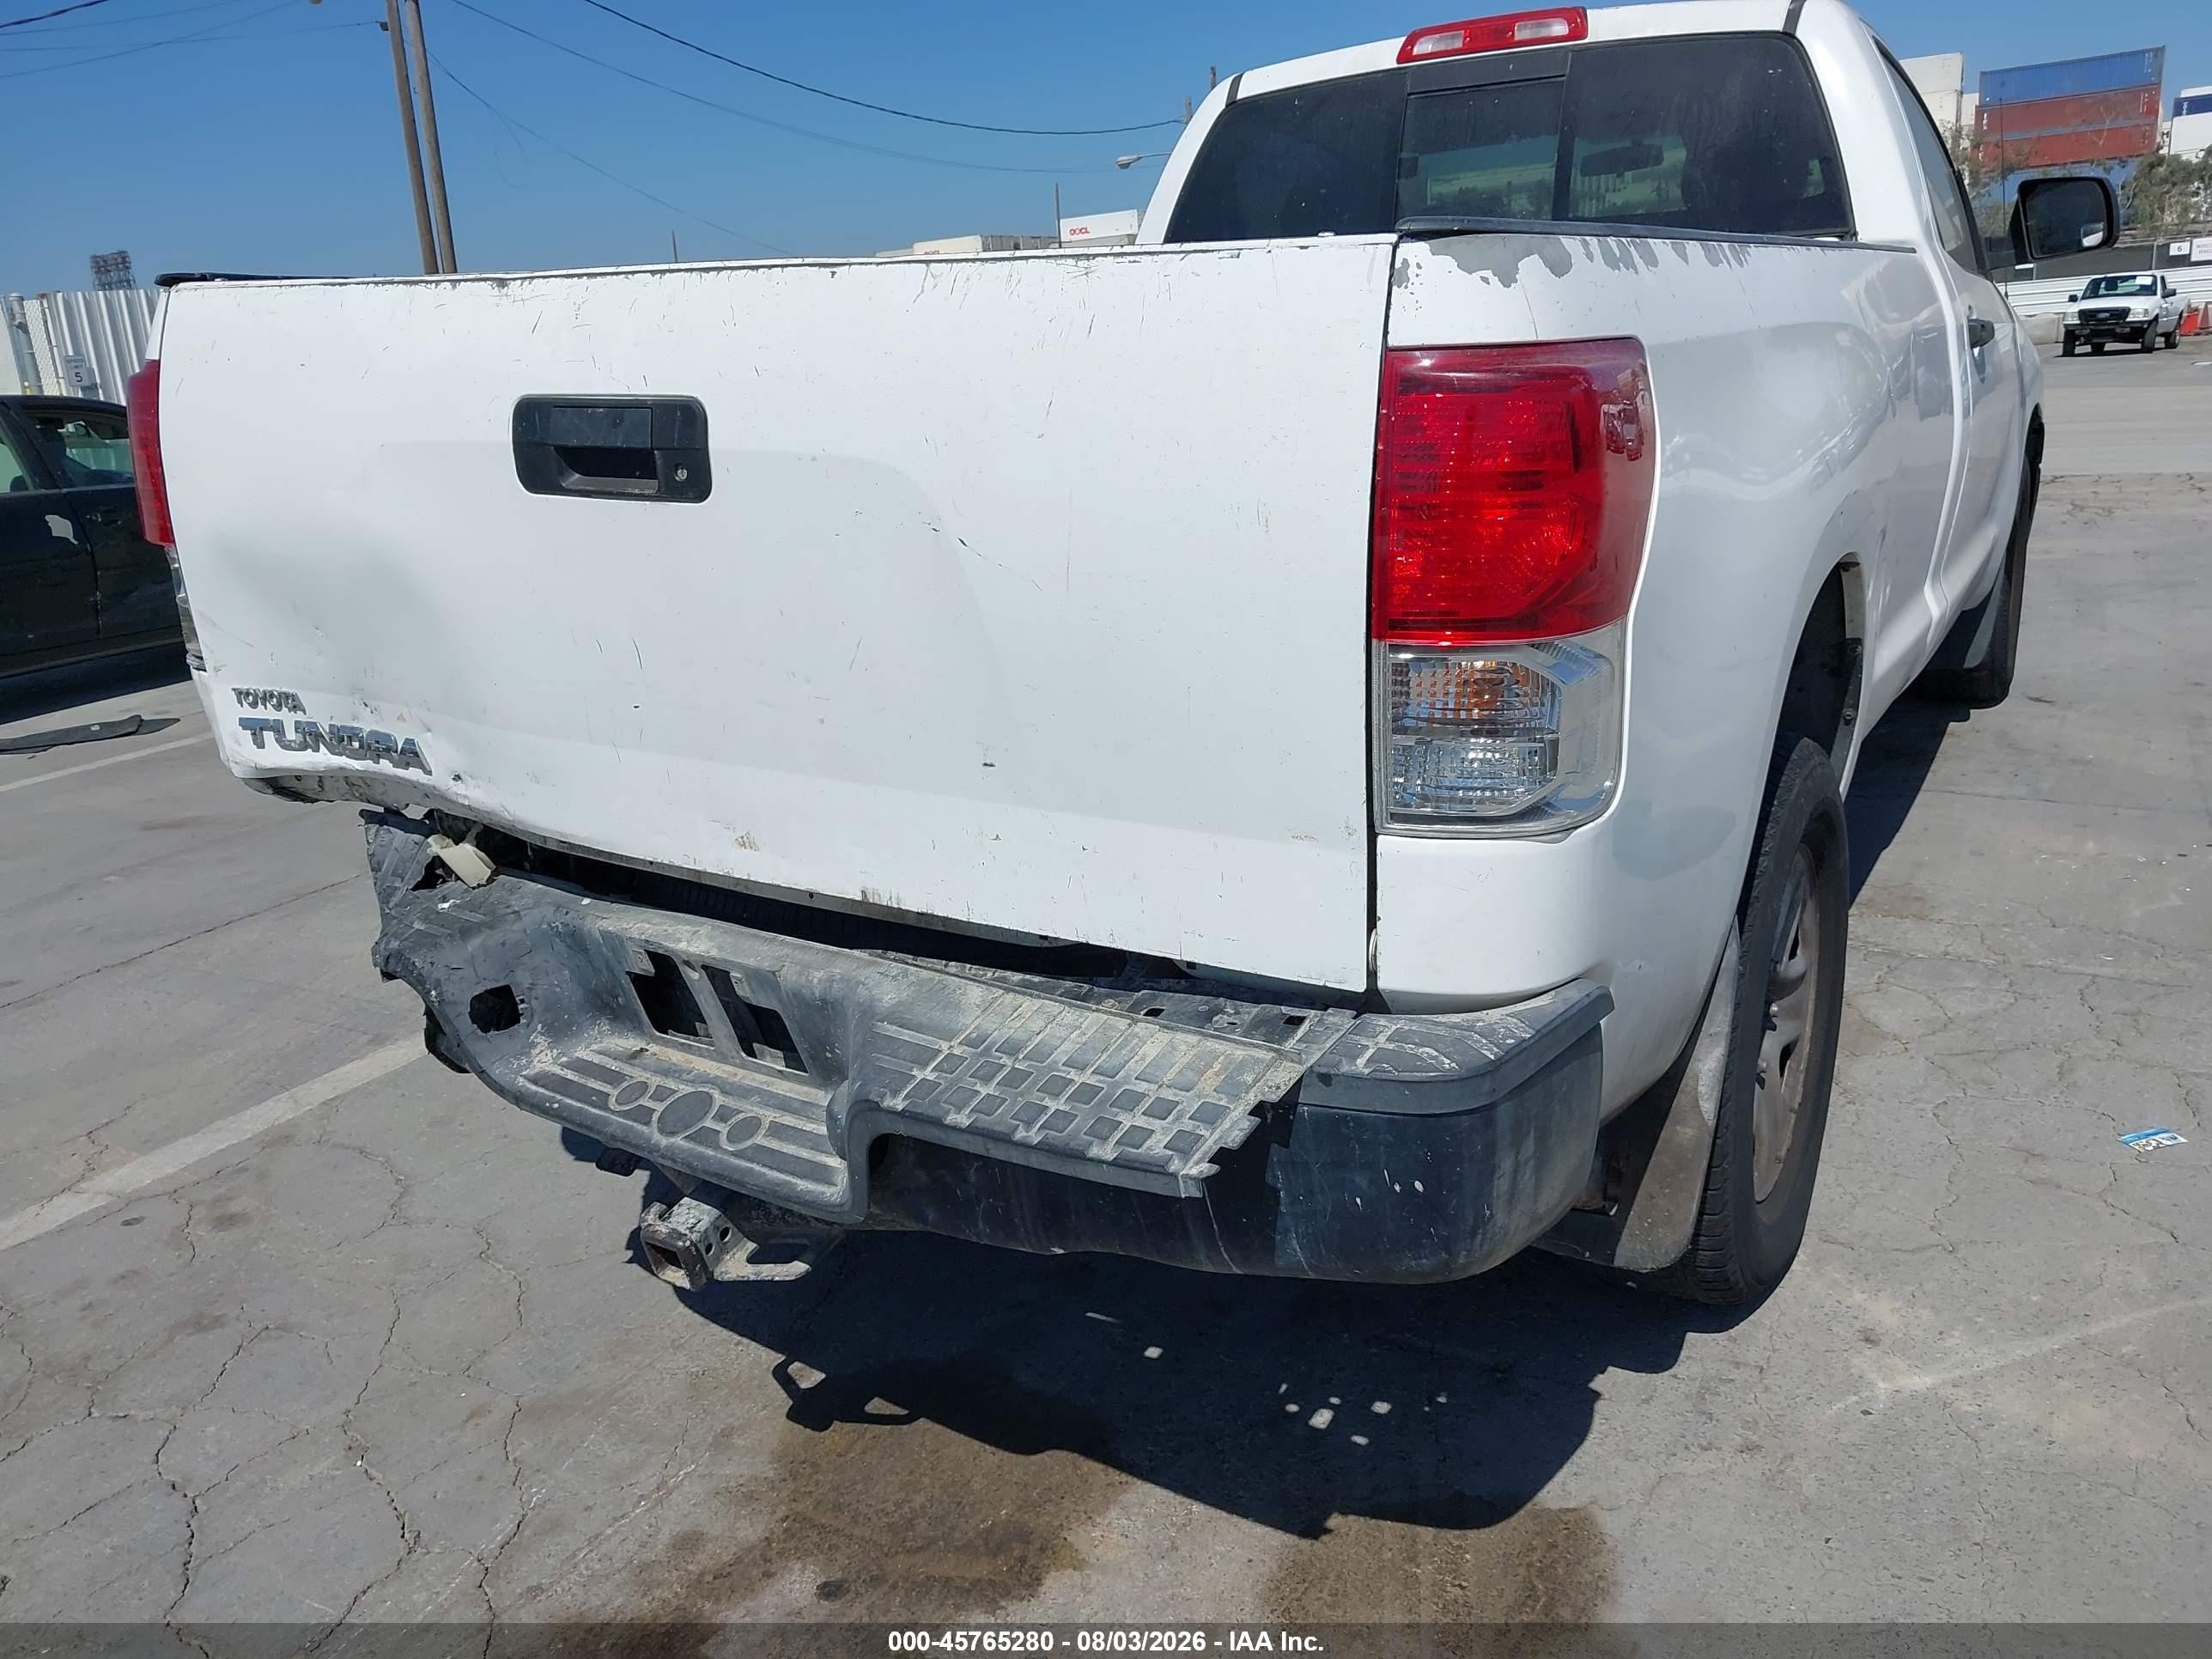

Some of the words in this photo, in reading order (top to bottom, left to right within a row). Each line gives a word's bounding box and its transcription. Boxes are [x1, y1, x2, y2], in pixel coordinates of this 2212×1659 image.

[75, 372, 83, 383] 5
[231, 688, 307, 715] TOYOTA
[238, 716, 433, 777] TUNDRA
